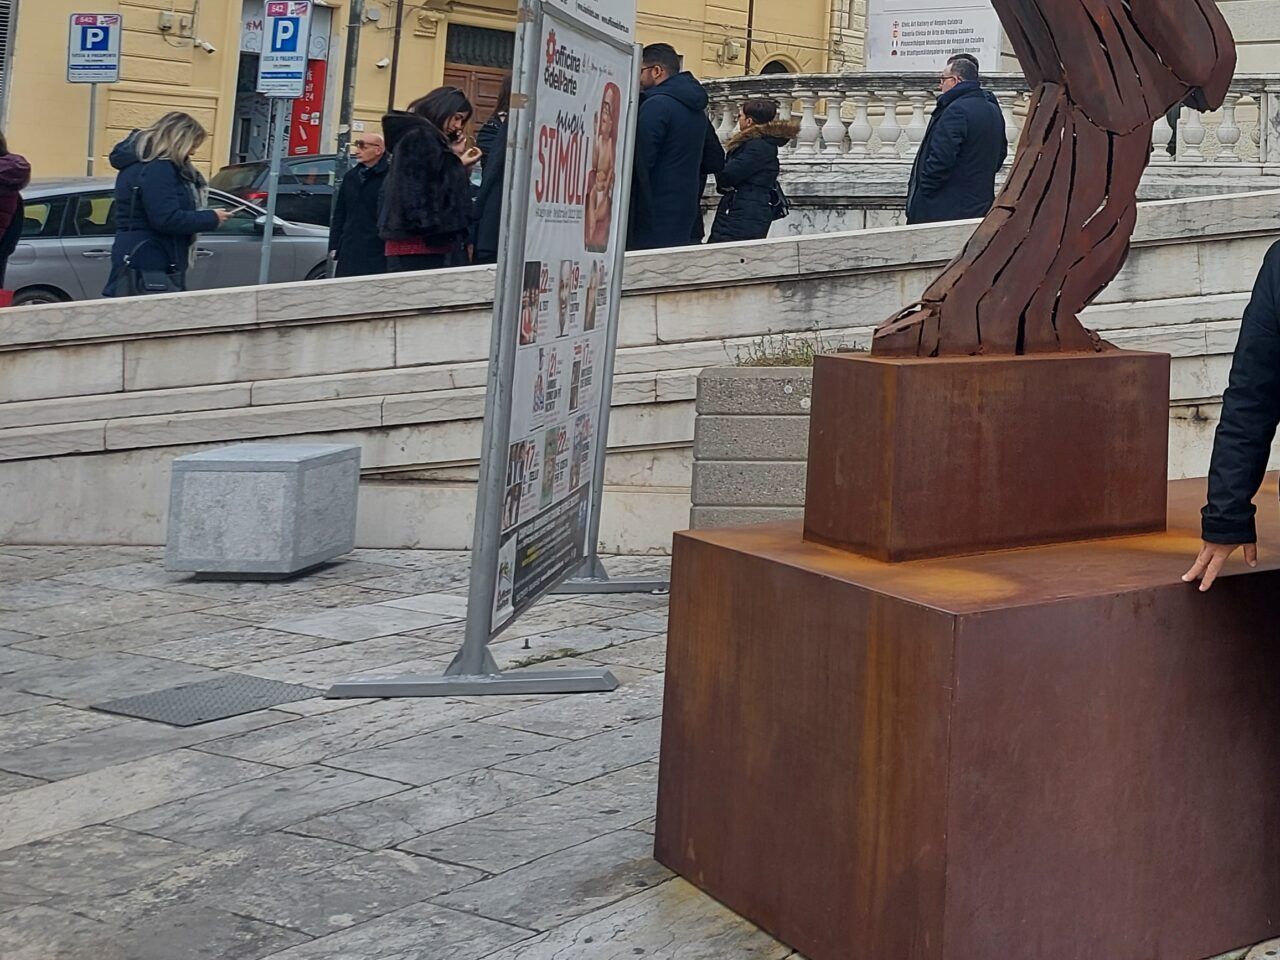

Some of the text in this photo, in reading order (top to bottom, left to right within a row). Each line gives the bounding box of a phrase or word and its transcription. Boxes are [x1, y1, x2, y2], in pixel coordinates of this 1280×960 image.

[86, 28, 104, 49] P
[275, 20, 294, 49] P
[555, 44, 581, 73] officina
[535, 124, 589, 206] STIMOLI
